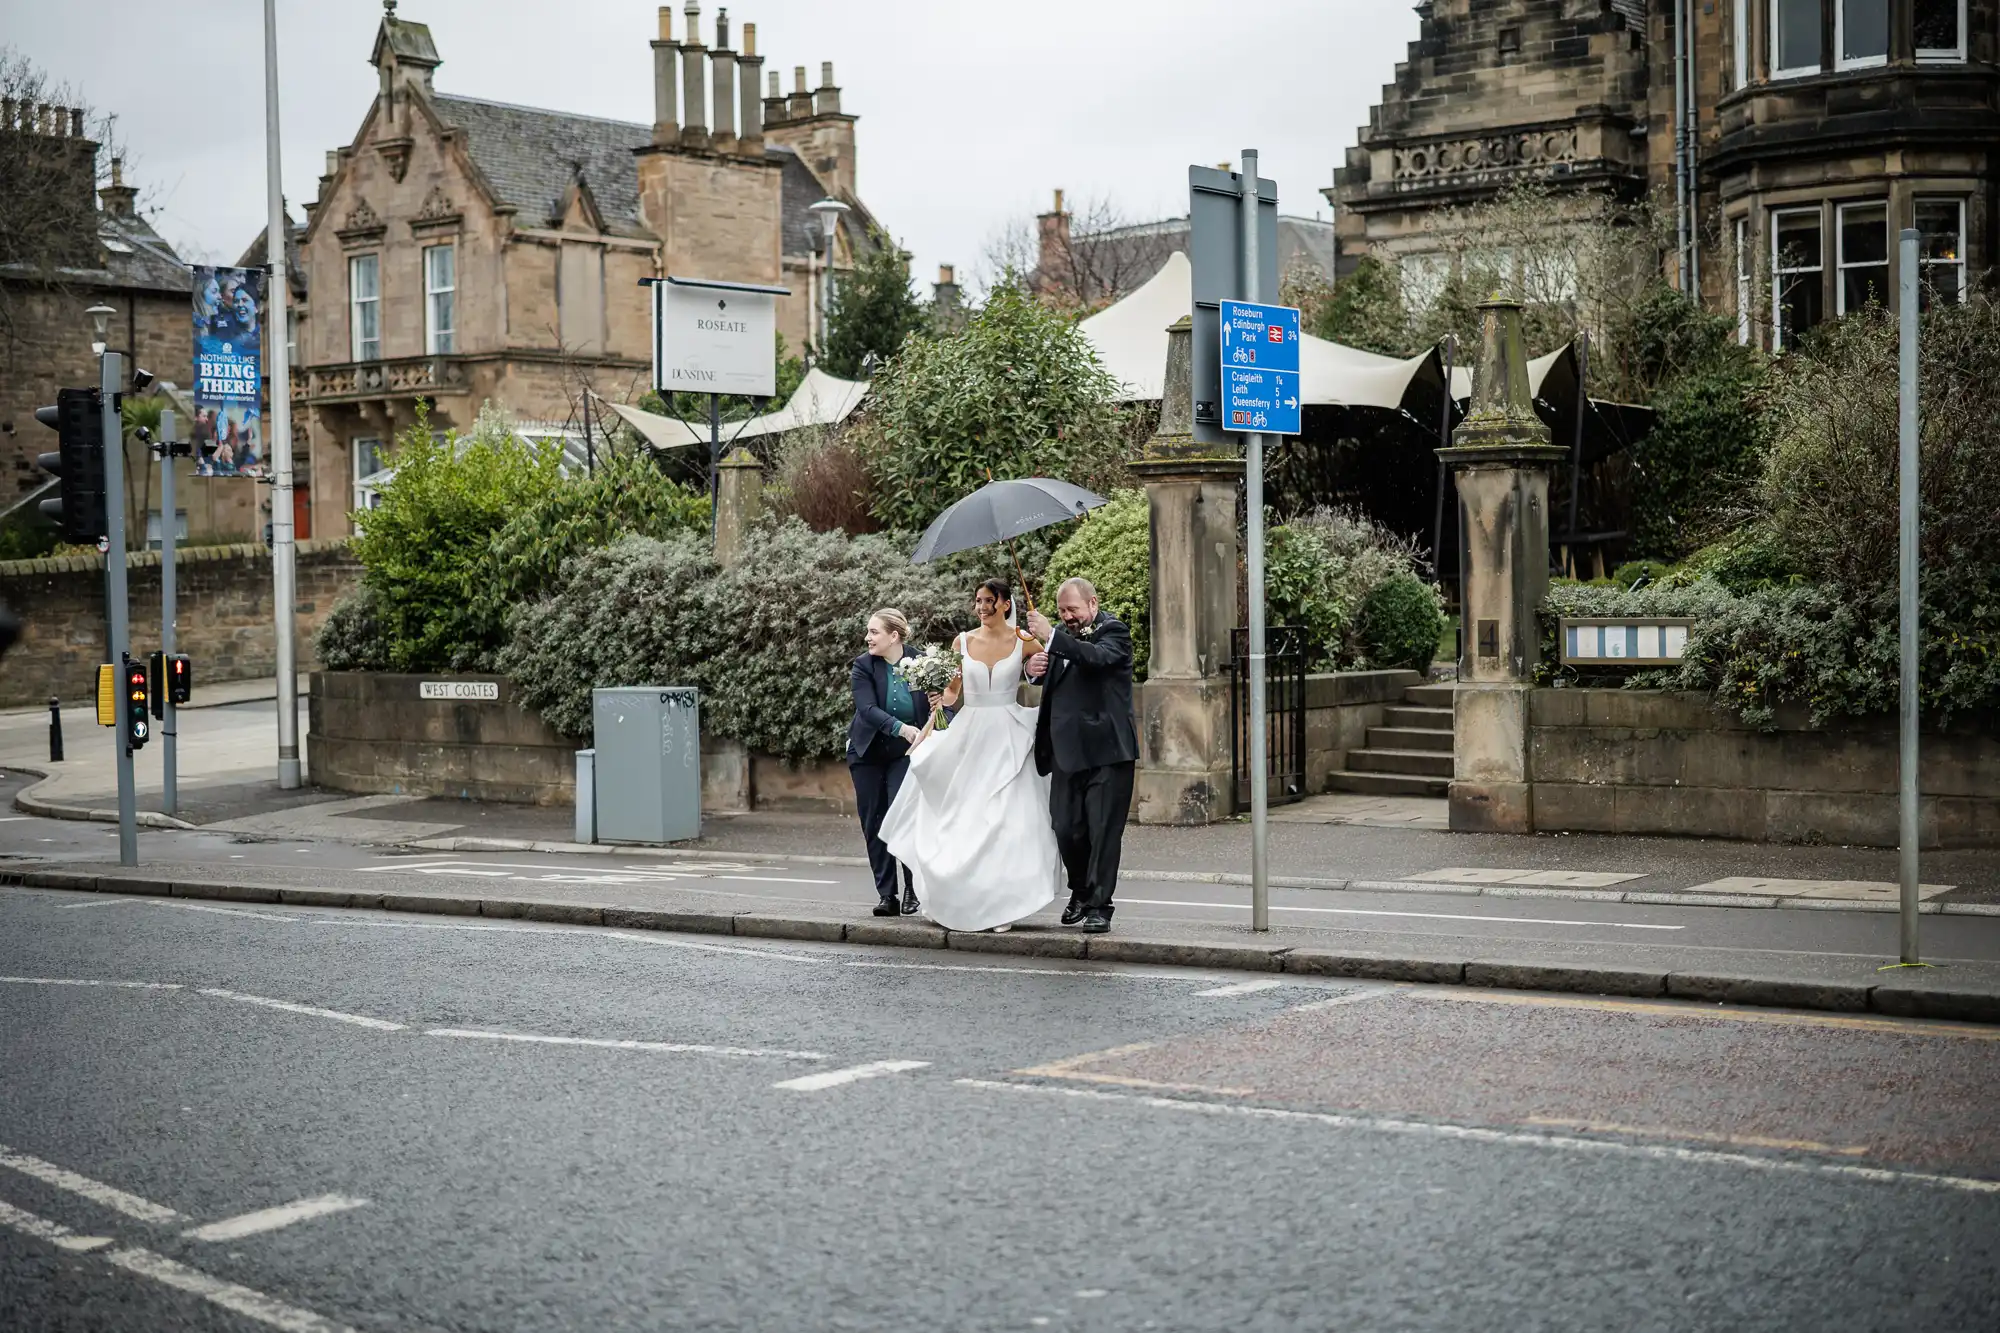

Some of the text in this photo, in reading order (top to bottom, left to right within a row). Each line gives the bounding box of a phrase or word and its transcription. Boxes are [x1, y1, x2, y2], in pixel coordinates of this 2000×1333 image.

[1233, 306, 1263, 319] Roseburn
[697, 319, 747, 333] ROSEATE
[1233, 319, 1265, 333] Edinburgh
[1242, 331, 1257, 343] Park
[200, 354, 255, 364] NOTHING LIKE
[200, 362, 256, 379] BEING
[1232, 371, 1263, 385] Craigleith
[200, 378, 256, 394] THERE
[1232, 383, 1280, 397] Leith 5
[1232, 395, 1280, 410] Queensferry 9
[1480, 623, 1497, 653] 4
[424, 684, 494, 697] WEST COATES
